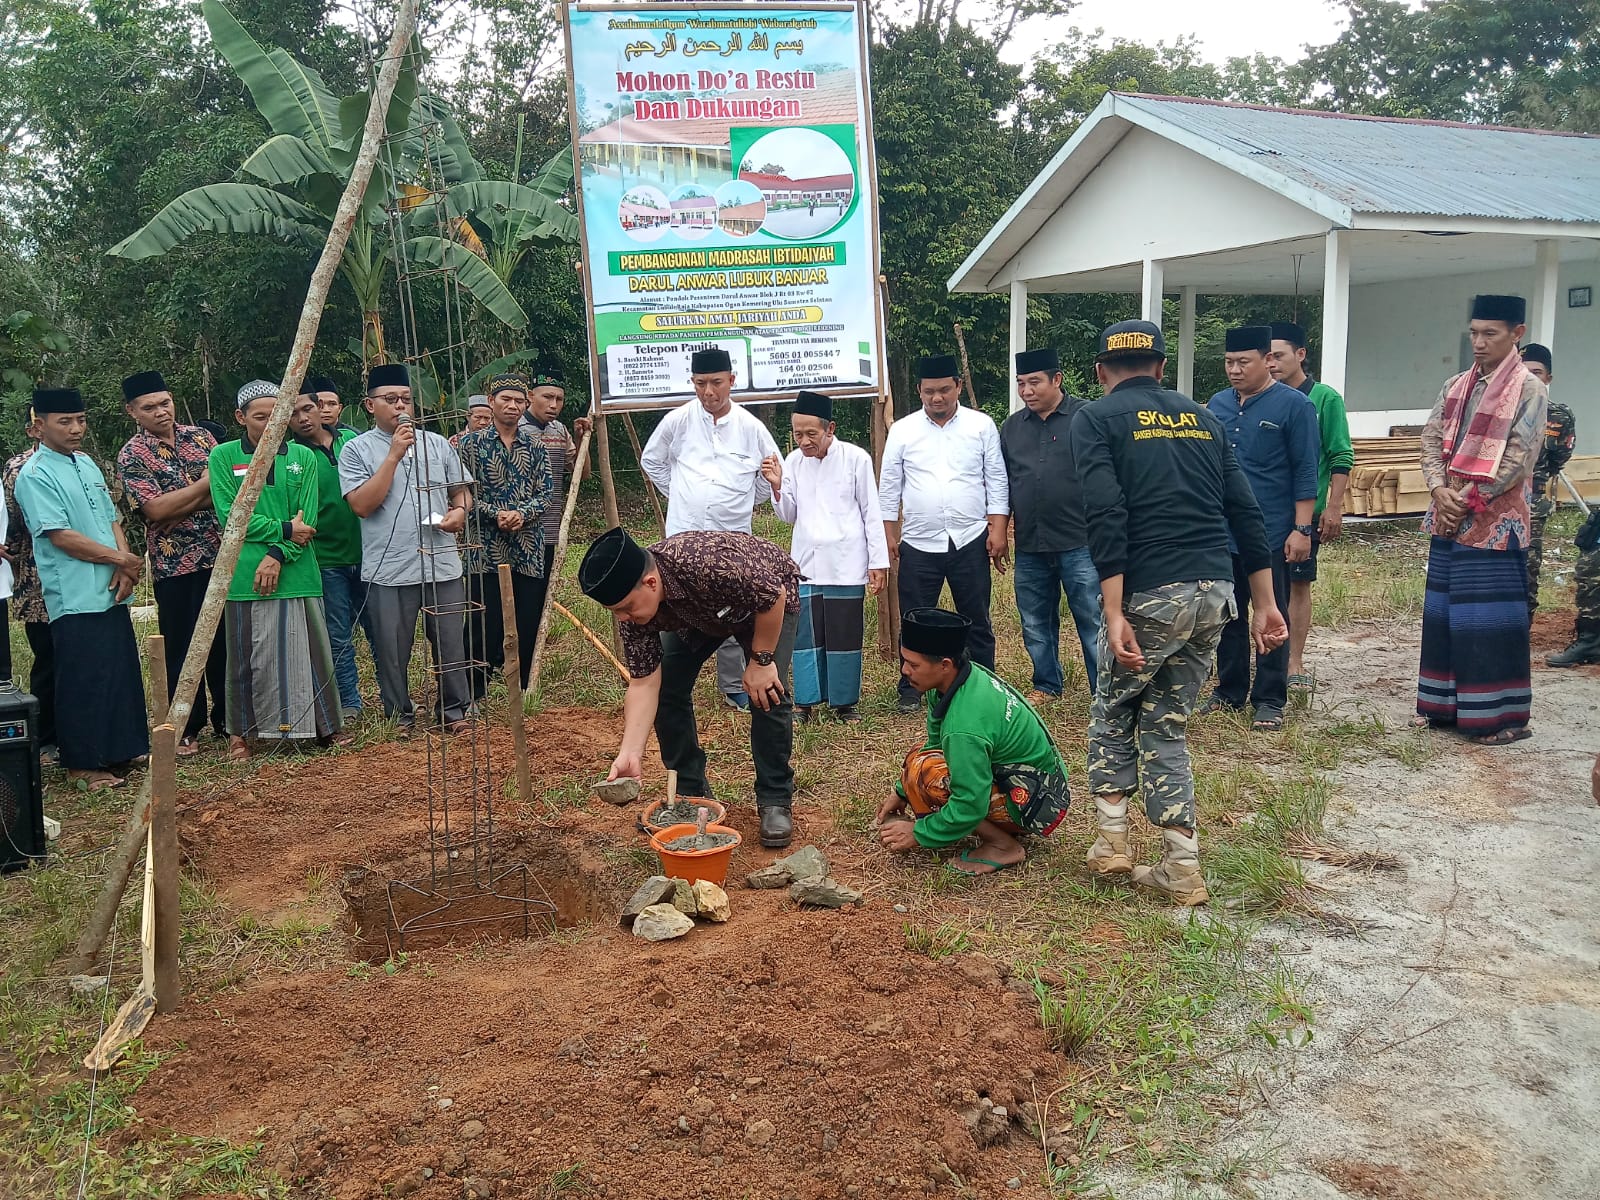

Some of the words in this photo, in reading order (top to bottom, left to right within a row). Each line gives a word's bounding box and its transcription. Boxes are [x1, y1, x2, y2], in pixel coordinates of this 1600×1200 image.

[625, 31, 676, 61] الرحيم
[683, 31, 742, 57] الرحمن
[748, 31, 768, 51] الله
[774, 39, 803, 59] بسم
[616, 71, 690, 92] Mohon
[697, 70, 749, 91] Do'a
[755, 69, 816, 89] Restu
[634, 100, 680, 120] Dan
[686, 97, 801, 119] Dukungan
[620, 251, 706, 271] PEMBANGUNAN
[708, 248, 772, 267] MADRASAH
[773, 244, 835, 265] IBTIDAIYAH
[629, 274, 674, 293] DARUL
[676, 272, 728, 291] ANWAR
[729, 270, 774, 289] LUBUK
[775, 268, 828, 287] BANJAR
[656, 314, 706, 327] SALURKAN
[708, 312, 735, 325] AMAL
[736, 311, 778, 325] JARIYAH
[780, 309, 807, 321] ANDA
[634, 344, 677, 356] Telepon
[681, 341, 719, 352] Panitia
[769, 352, 790, 360] 5605
[791, 351, 801, 359] 01
[803, 350, 834, 358] 005544
[835, 349, 841, 357] 7
[779, 365, 794, 373] 164
[812, 375, 838, 383] ANWAR
